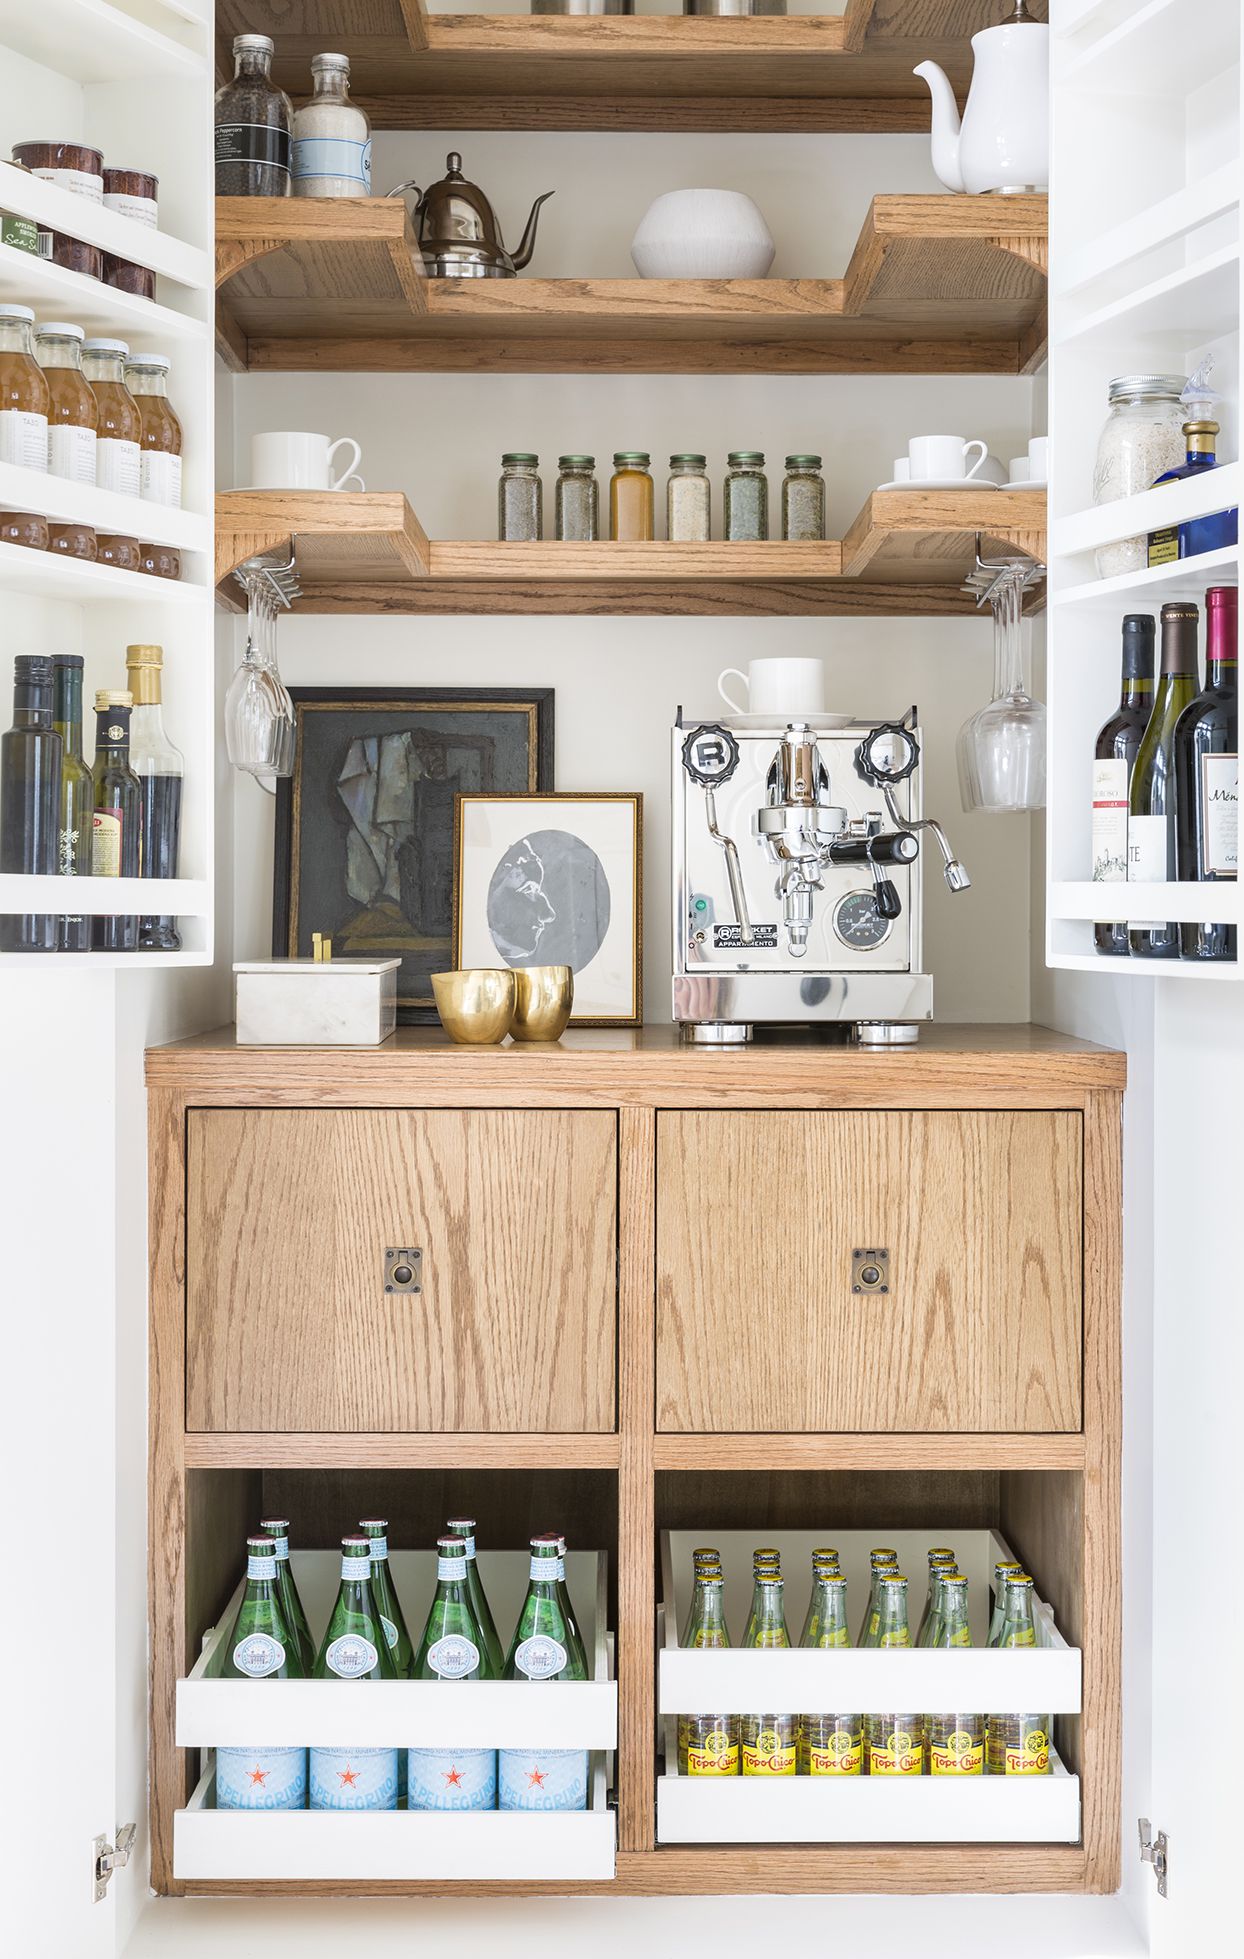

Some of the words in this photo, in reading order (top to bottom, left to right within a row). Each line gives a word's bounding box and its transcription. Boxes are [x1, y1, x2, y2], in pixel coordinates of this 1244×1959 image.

[696, 741, 725, 767] R
[743, 1751, 766, 1767] Topo
[811, 1753, 837, 1769] Topo
[871, 1752, 897, 1768] Topo
[931, 1752, 957, 1768] Topo
[1007, 1754, 1035, 1770] Topo
